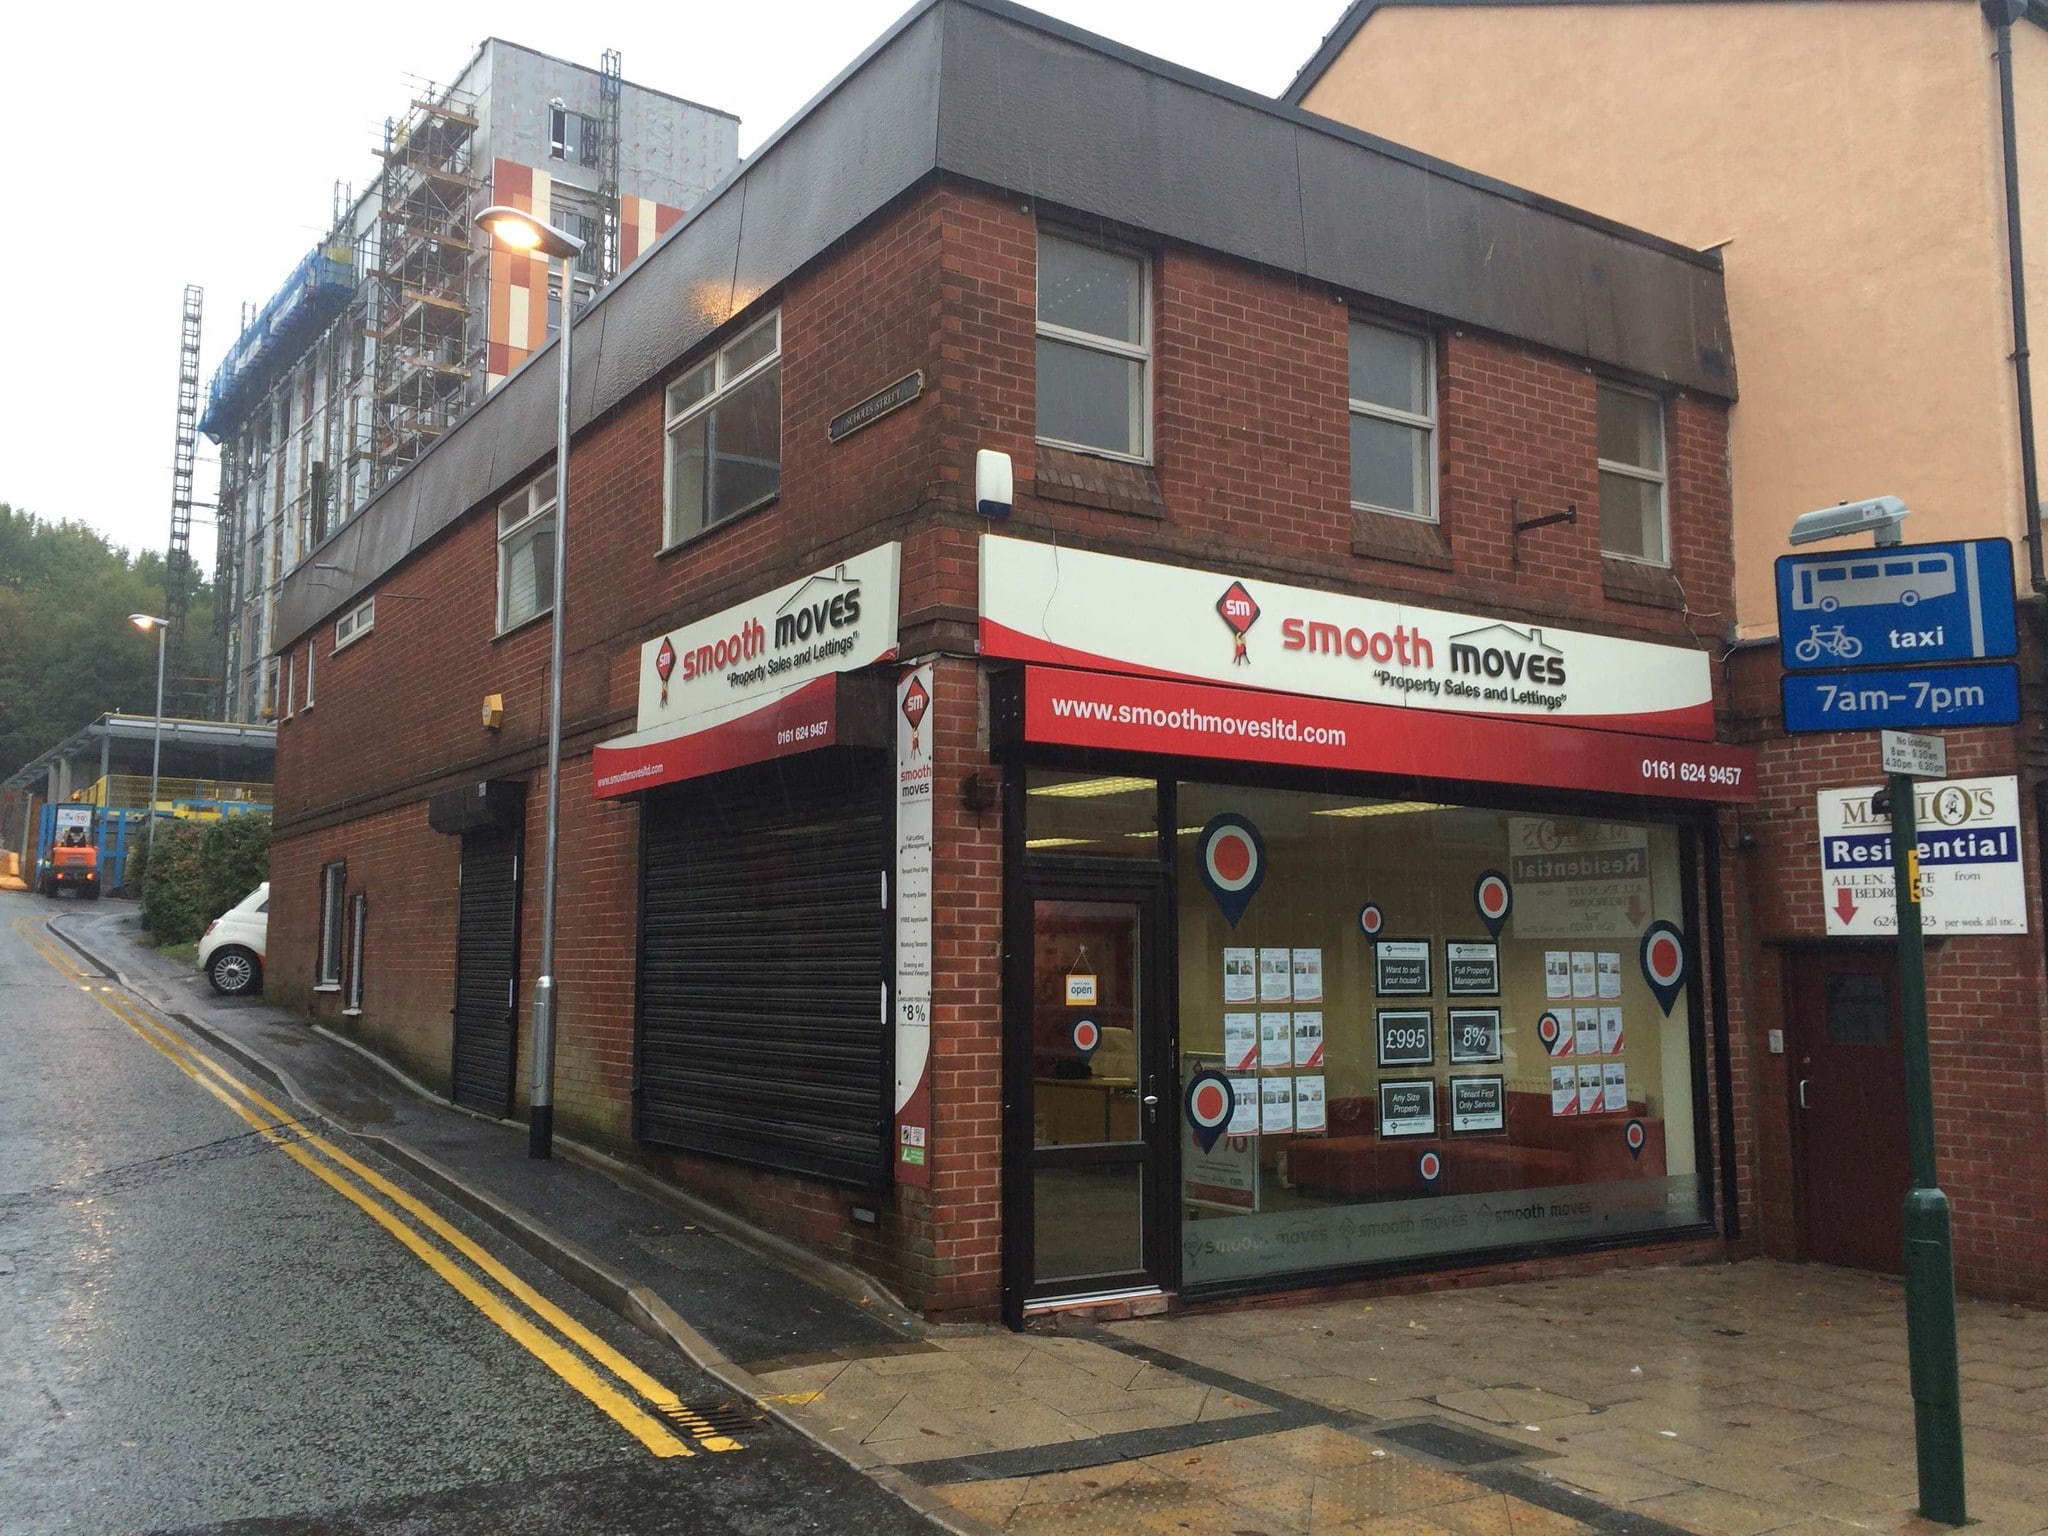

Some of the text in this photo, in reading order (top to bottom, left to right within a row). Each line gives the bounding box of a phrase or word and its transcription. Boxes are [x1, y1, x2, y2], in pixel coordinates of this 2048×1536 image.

[876, 389, 901, 410] STREET
[1226, 599, 1250, 617] sm
[682, 587, 861, 681] smooth moves
[1888, 625, 1944, 649] taxi
[658, 651, 671, 667] sm
[1281, 617, 1567, 686] smooth moves
[767, 659, 792, 675] Sales
[793, 647, 811, 666] and
[1444, 678, 1481, 699] Sales
[1484, 684, 1509, 702] and
[1051, 697, 1346, 747] www.smoothmovesltd.com
[777, 721, 828, 745] 0161 624 9457
[1896, 736, 1906, 746] No
[900, 764, 932, 782] smooth
[1642, 758, 1742, 785] 0161 624 9457
[902, 782, 930, 797] moves
[1842, 786, 1995, 826] MIO'S
[1831, 831, 2009, 863] Resiential
[1831, 874, 1860, 887] ALL
[1954, 871, 1981, 881] from
[1854, 886, 1935, 899] BEDROS
[1944, 919, 1960, 929] per
[1961, 917, 1983, 927] week
[1986, 916, 1998, 926] all
[1385, 965, 1420, 974] Want to sell
[1454, 966, 1491, 976] Full Property
[1385, 976, 1421, 986] your house?
[1454, 977, 1492, 987] Management
[1070, 985, 1092, 997] open
[1385, 1028, 1426, 1049] £995
[1462, 1026, 1487, 1047] 8%
[1392, 1093, 1420, 1104] Any Size
[1460, 1089, 1495, 1099] Tenant Find
[1393, 1104, 1420, 1114] Property
[1459, 1099, 1496, 1110] Only Service
[1494, 1200, 1592, 1222] smooth moves
[1357, 1212, 1468, 1239] smooth moves
